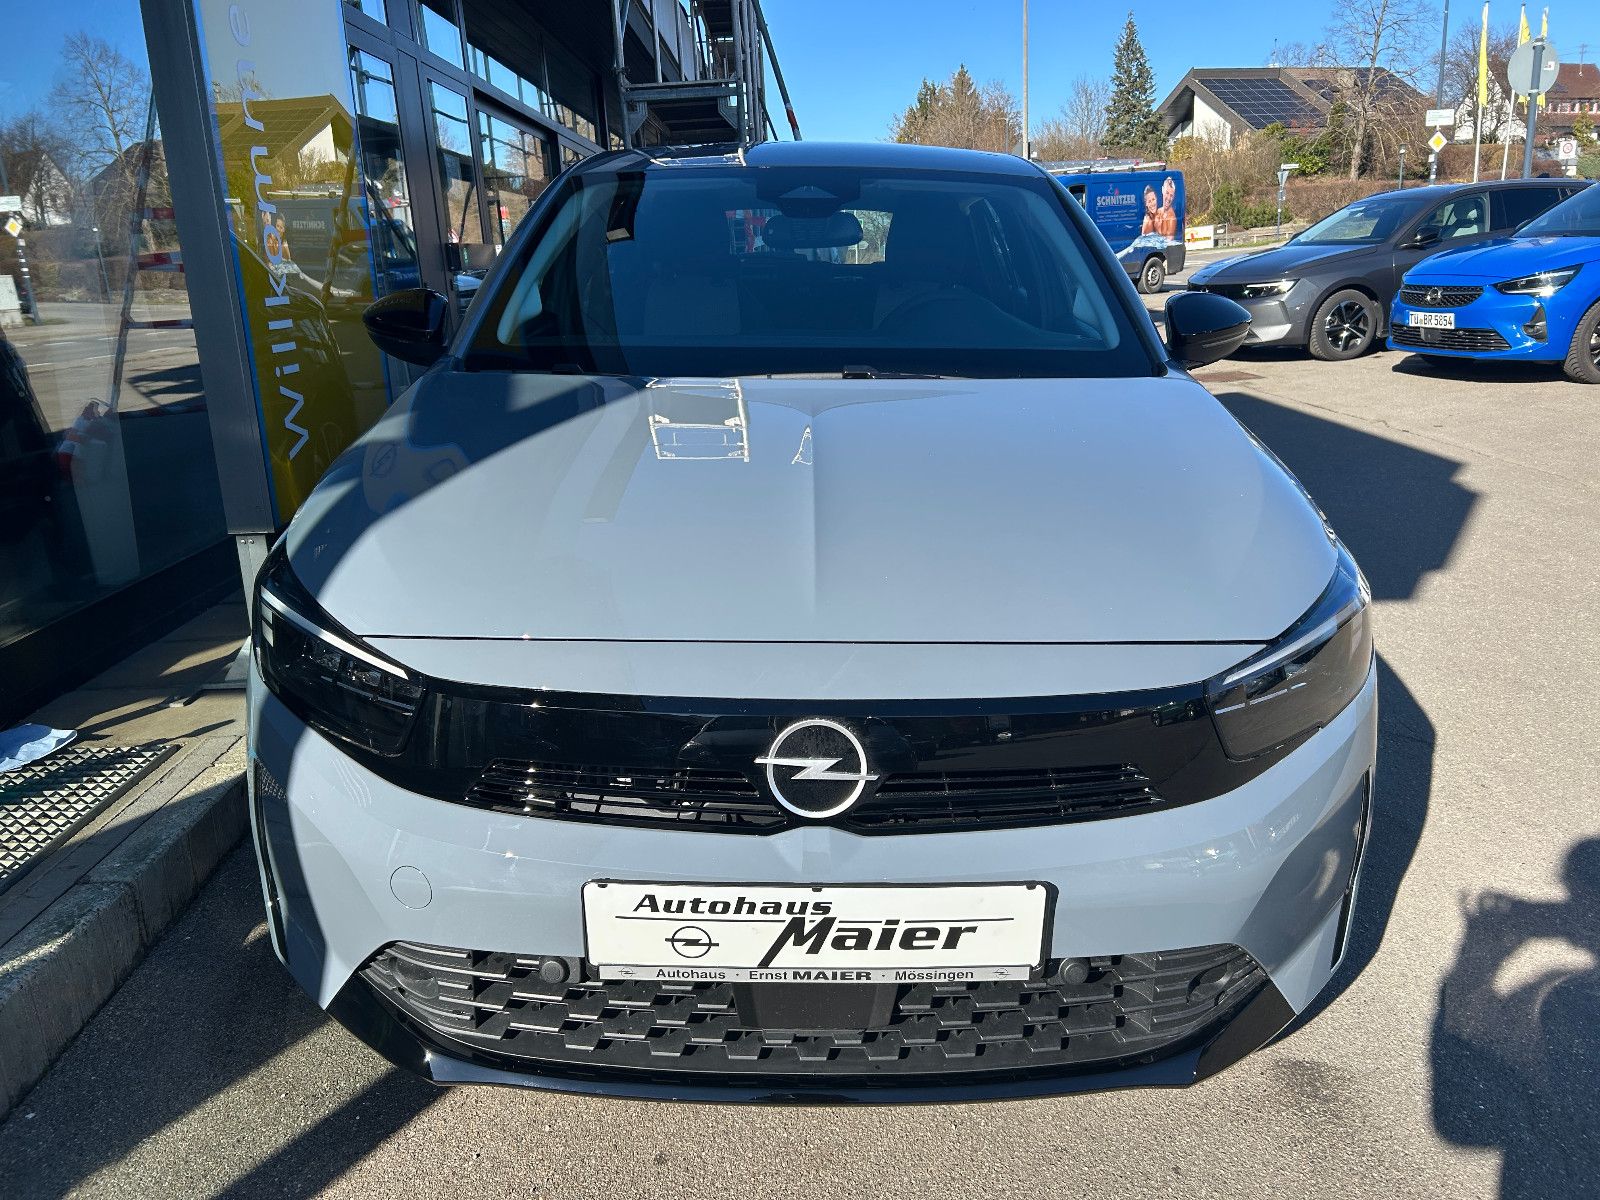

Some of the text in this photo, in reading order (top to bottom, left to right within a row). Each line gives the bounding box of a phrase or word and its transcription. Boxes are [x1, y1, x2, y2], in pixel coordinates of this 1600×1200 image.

[1096, 194, 1136, 206] SCHNITZER
[632, 893, 833, 916] Autohaus
[757, 916, 979, 969] Maier
[656, 968, 974, 982] Autohaus Ernst MAIER Mössingen
